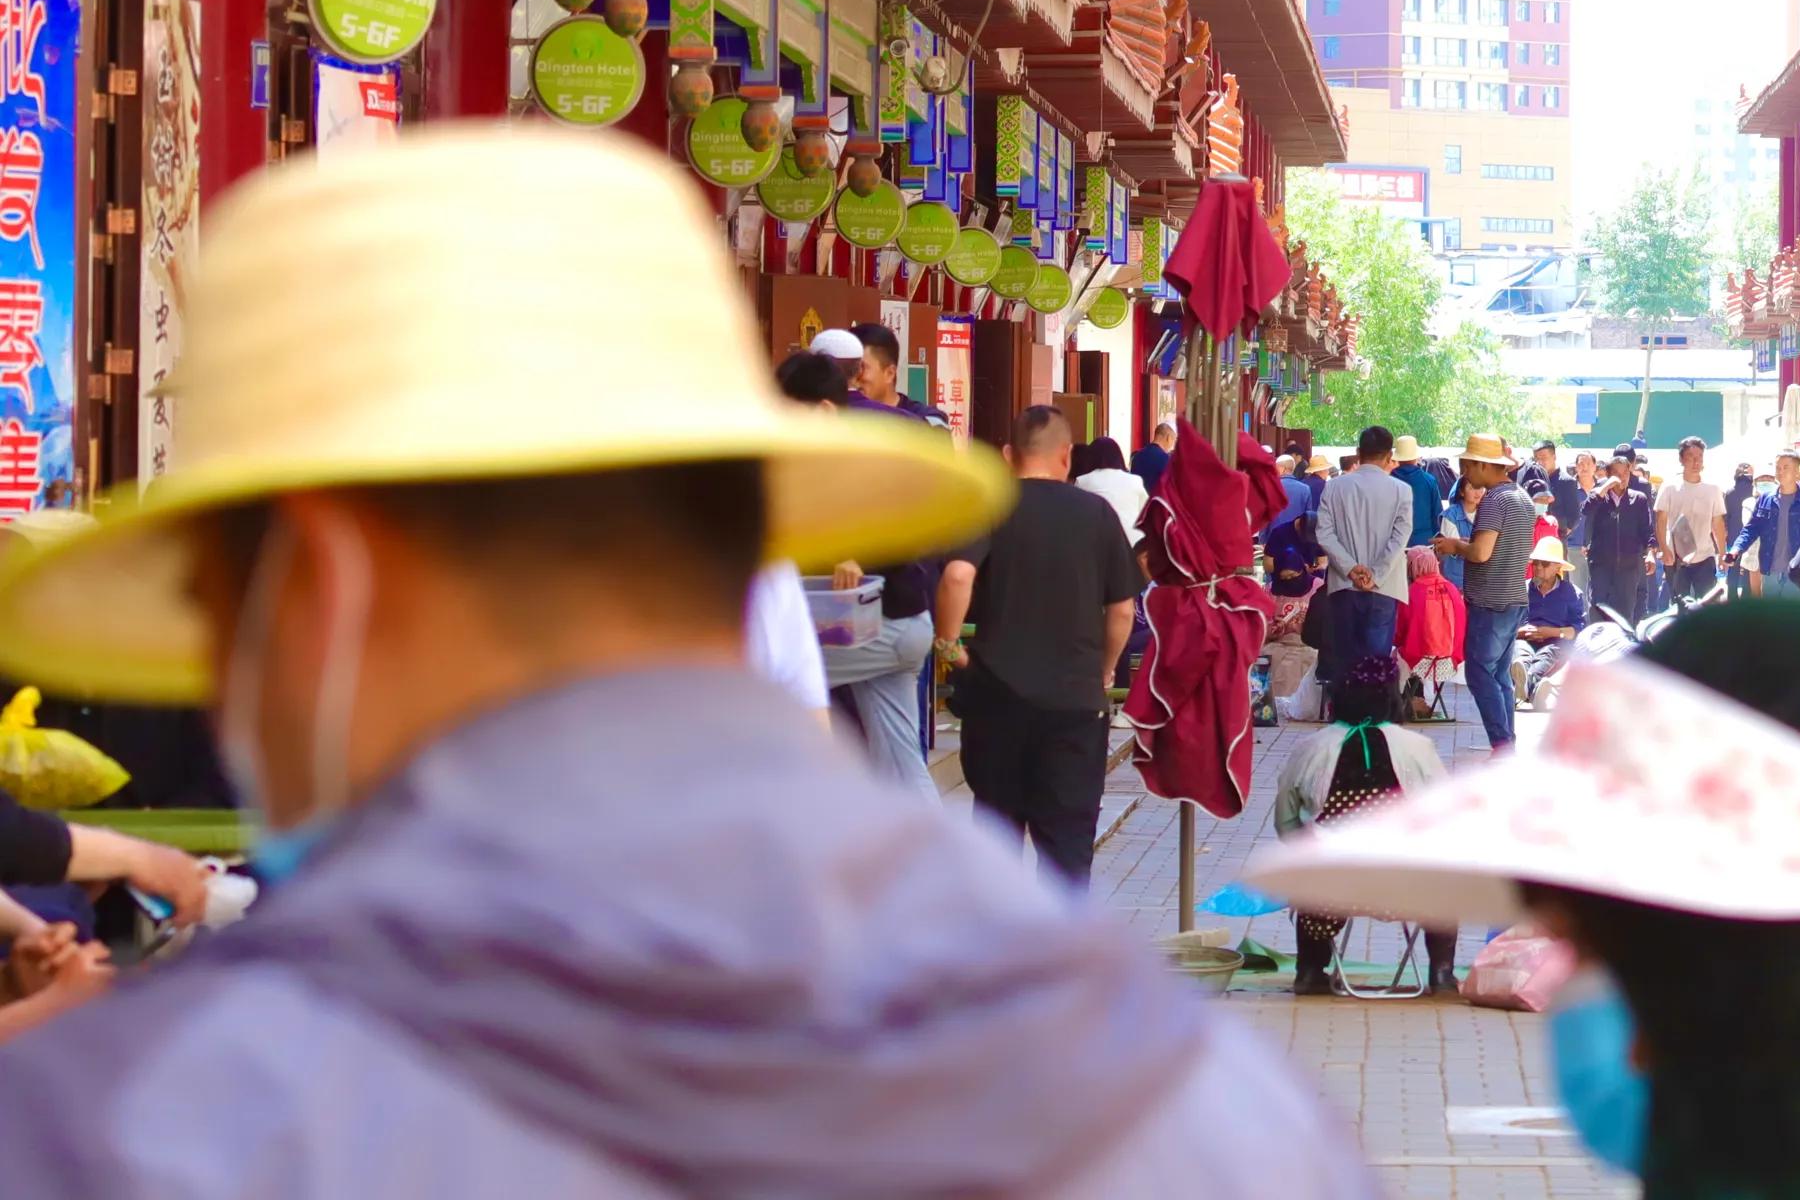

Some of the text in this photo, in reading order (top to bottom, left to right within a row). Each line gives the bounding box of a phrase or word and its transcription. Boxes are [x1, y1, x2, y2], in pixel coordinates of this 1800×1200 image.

[340, 13, 401, 49] 5-6F
[597, 63, 636, 76] Hotel
[557, 94, 612, 115] 5-6F
[710, 159, 756, 176] 5-6F
[776, 199, 815, 214] 5-6F
[850, 227, 885, 240] 5-6F
[910, 244, 943, 257] 5-6F
[959, 267, 987, 280] 5-6F
